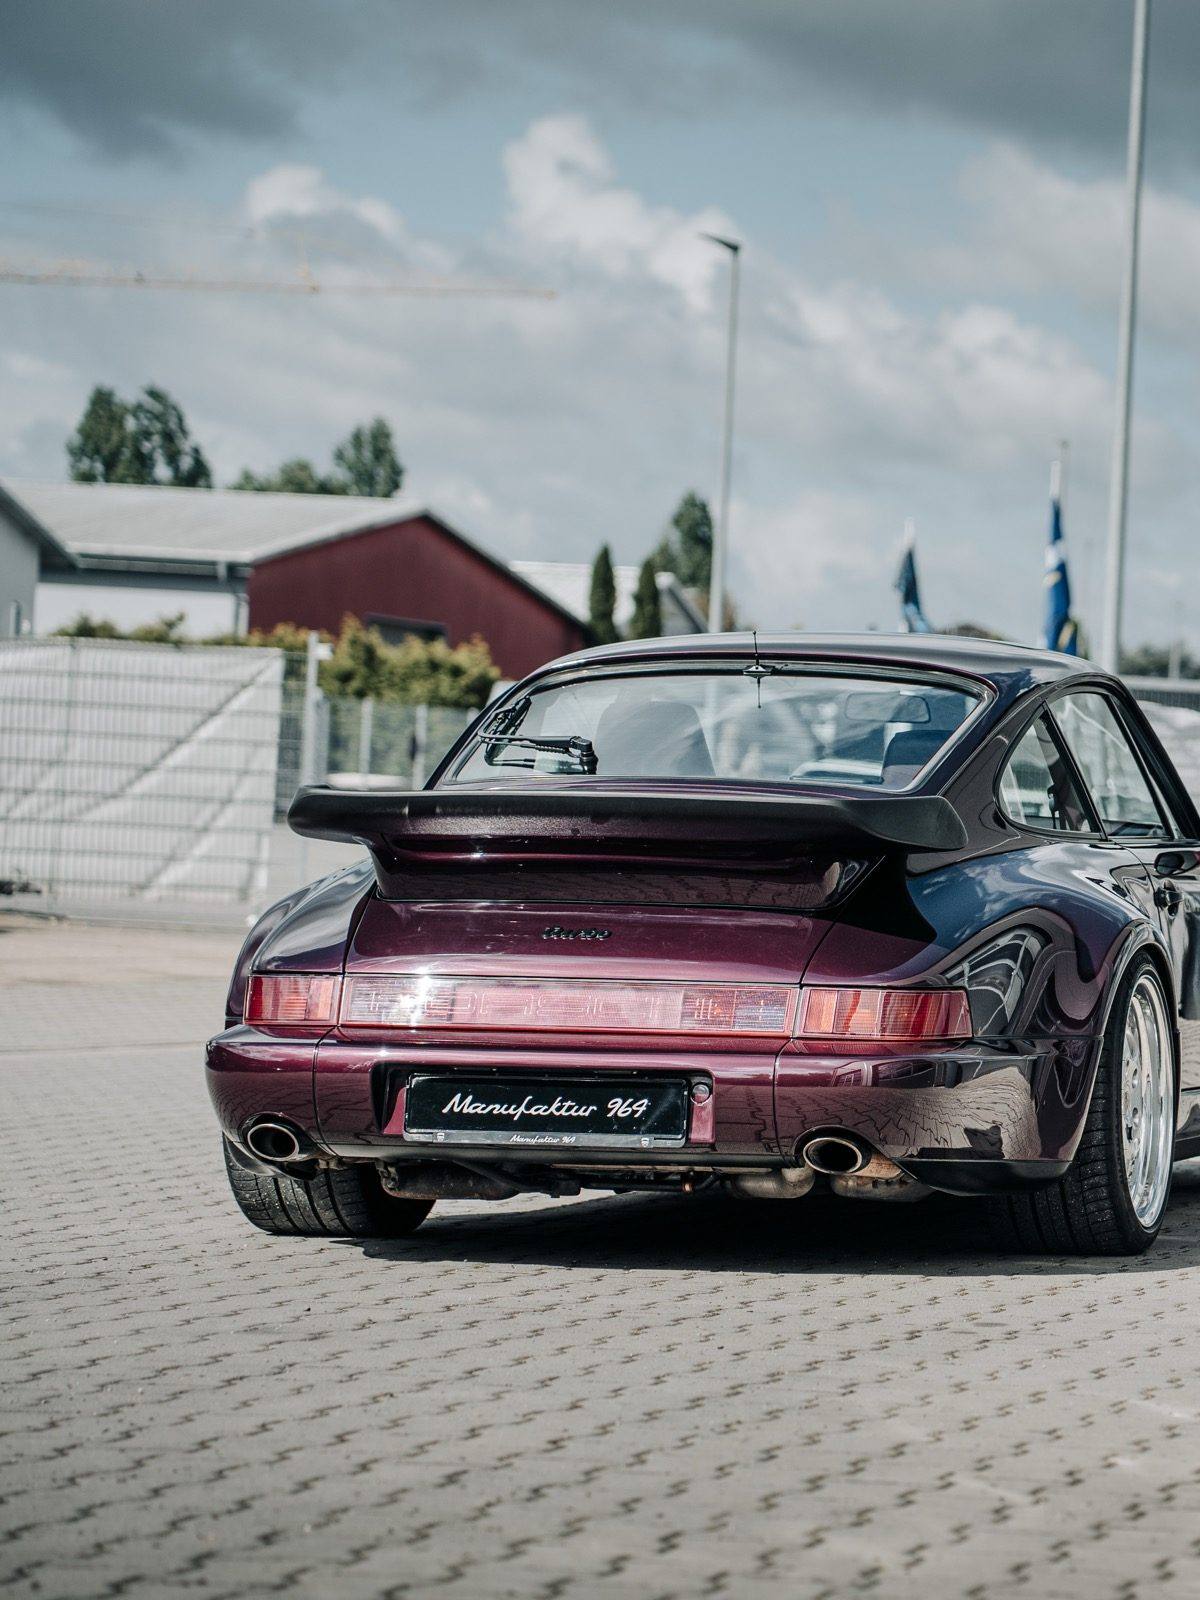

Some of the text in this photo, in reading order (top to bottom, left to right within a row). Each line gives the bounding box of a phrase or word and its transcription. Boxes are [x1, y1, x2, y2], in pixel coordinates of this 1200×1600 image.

[442, 1092, 649, 1120] Manufaktur 964
[510, 1134, 576, 1144] Manufaktur 964
